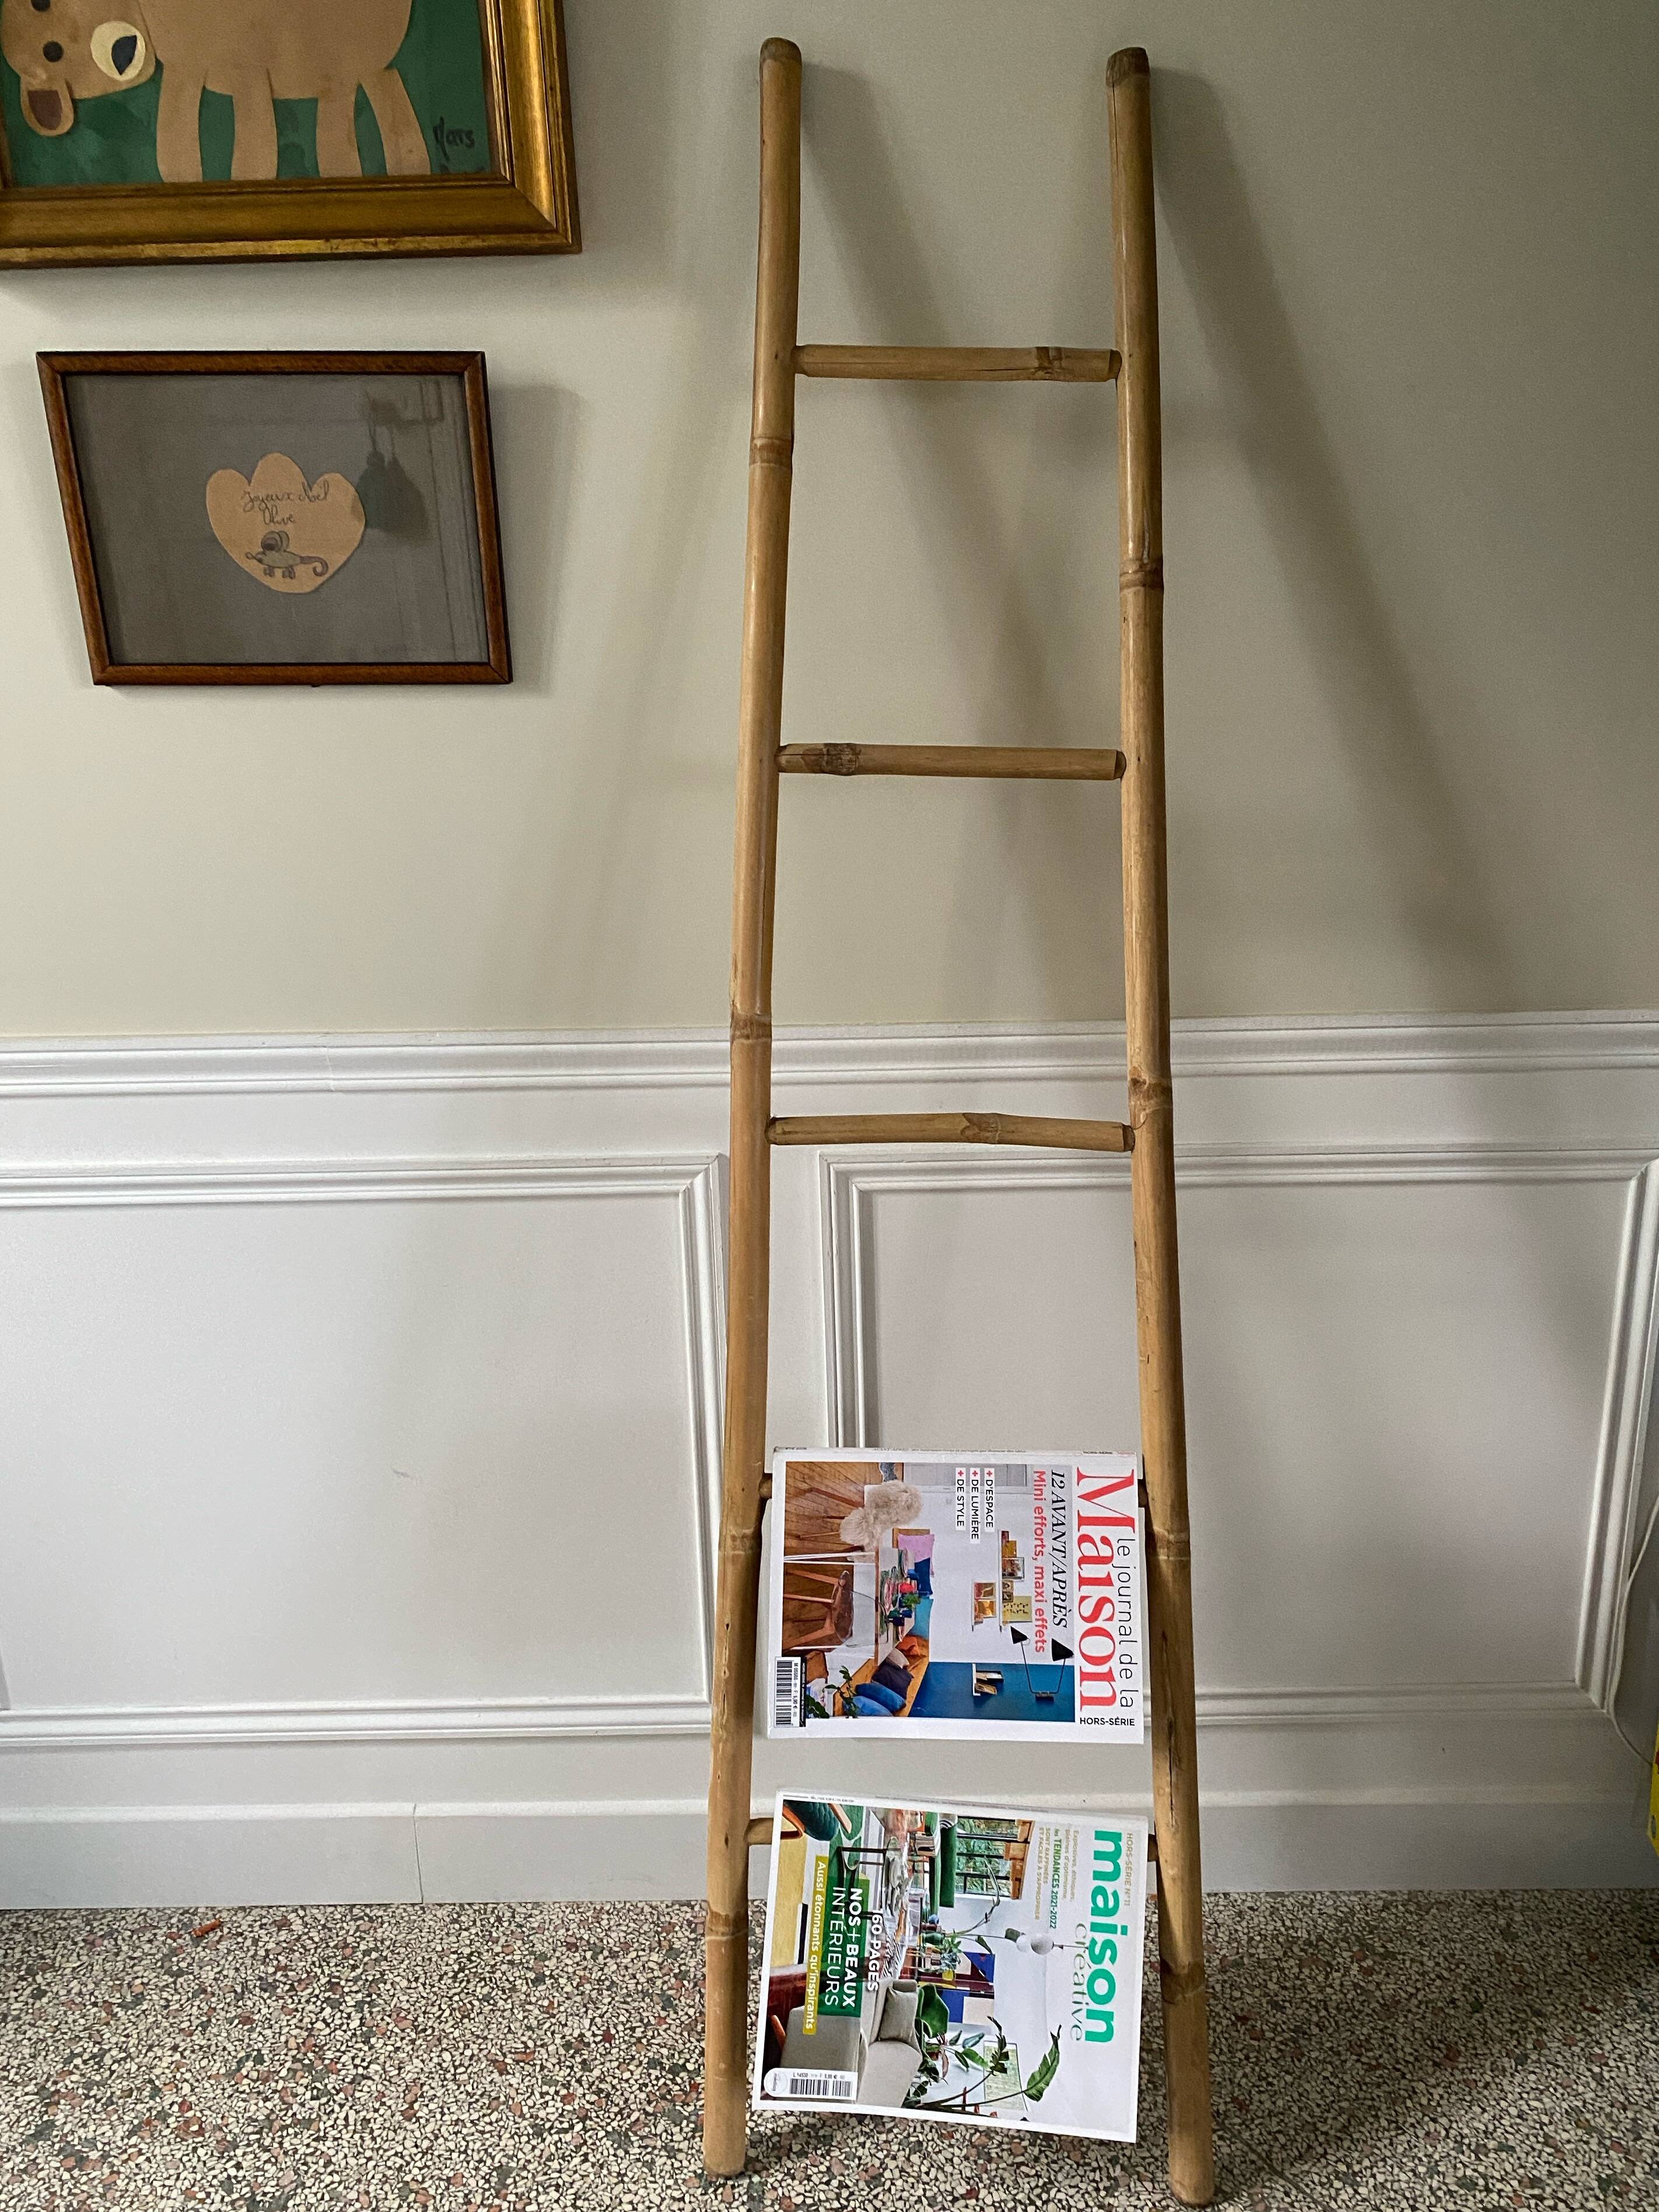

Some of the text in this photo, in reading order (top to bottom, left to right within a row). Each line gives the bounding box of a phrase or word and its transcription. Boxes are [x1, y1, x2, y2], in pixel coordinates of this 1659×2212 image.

[957, 1479, 965, 1491] DE
[957, 1493, 965, 1527] STYLE
[971, 1479, 979, 1491] DE
[971, 1493, 981, 1540] LUMIÈRE
[985, 1479, 993, 1528] D'ESPACE
[1032, 1470, 1048, 1653] Mini efforts, maxi effets
[1048, 1469, 1073, 1629] 12 AVANT/APRÈS
[1077, 1466, 1135, 1712] Maison
[1112, 1538, 1139, 1708] le journal de la
[1079, 1716, 1136, 1727] HORS-SÉRIE
[1052, 1839, 1062, 1889] TENDANCES
[1124, 1832, 1133, 1889] HORS-SÉRIE
[1049, 1890, 1058, 1930] 2021-2022
[1085, 1830, 1129, 2043] maison
[806, 1861, 827, 2030] Aussi étonnants qu'inspirants
[825, 1887, 846, 2007] INTÉRIEURS
[867, 1908, 883, 1992] 160 PAGES
[1069, 1923, 1092, 2042] créative
